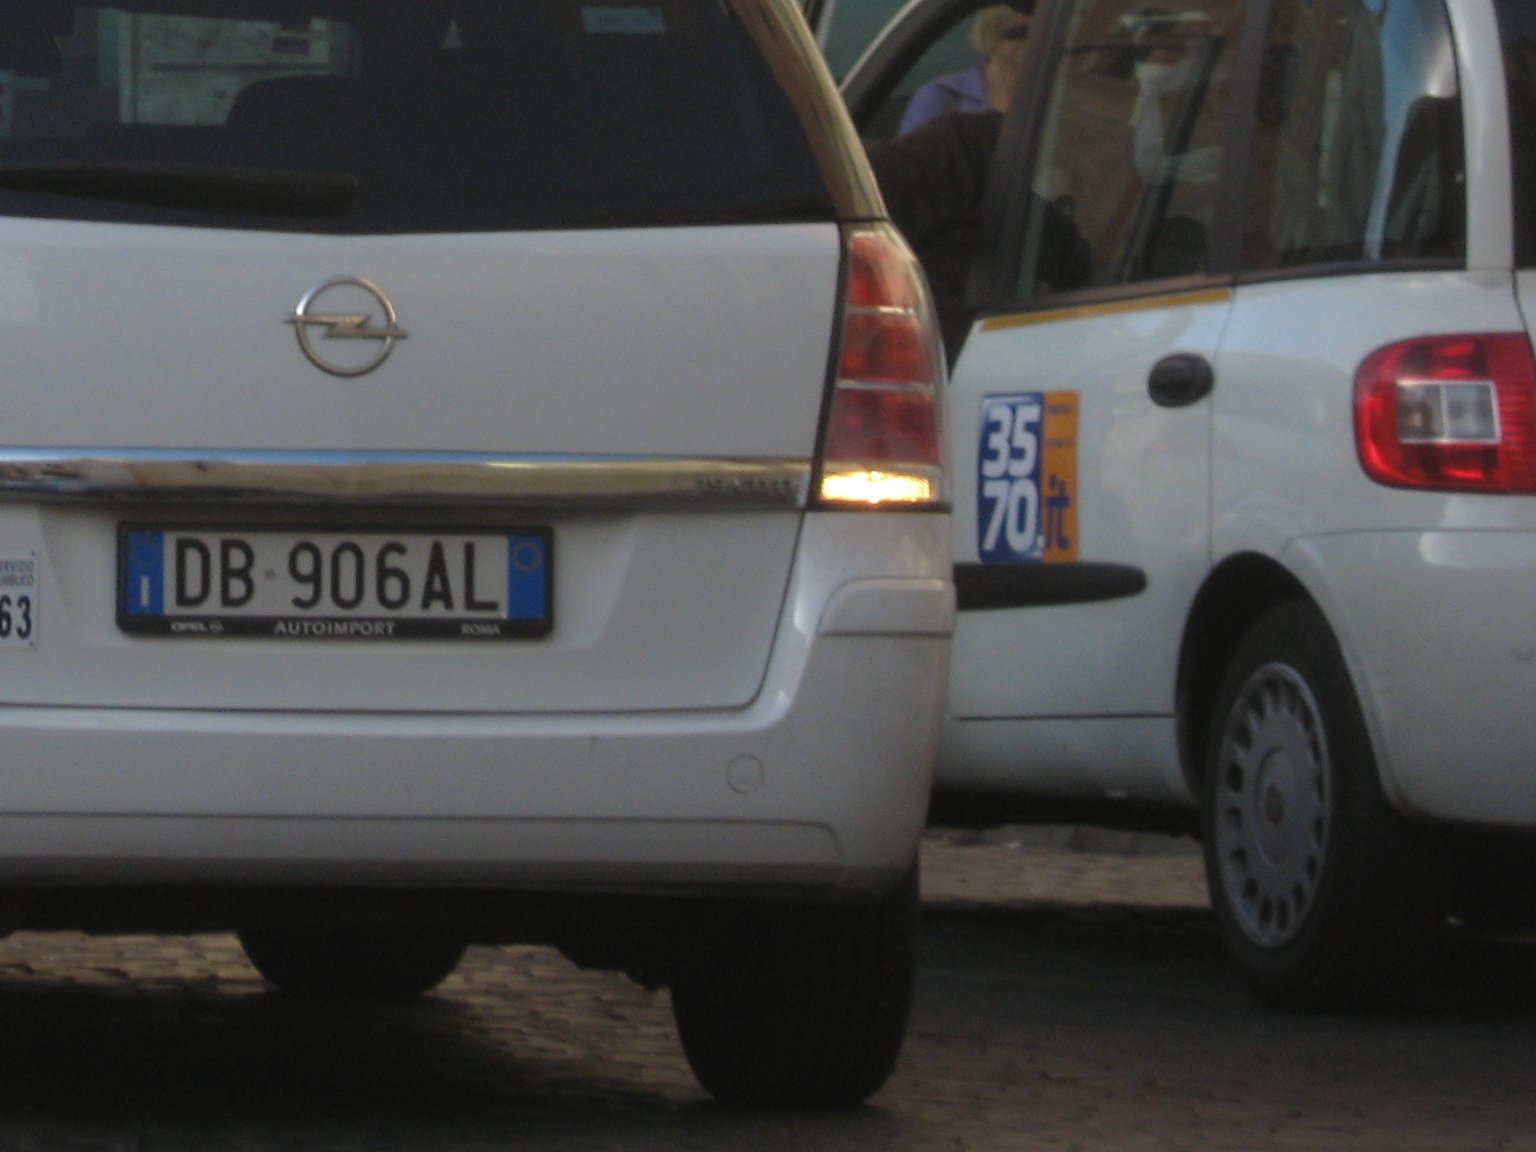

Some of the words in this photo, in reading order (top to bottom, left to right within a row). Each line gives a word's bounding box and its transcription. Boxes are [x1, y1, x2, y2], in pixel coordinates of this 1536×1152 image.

[981, 403, 1043, 479] 35
[174, 537, 256, 608] DB
[288, 540, 500, 612] 906AL
[273, 620, 397, 637] AUTOIMPORT
